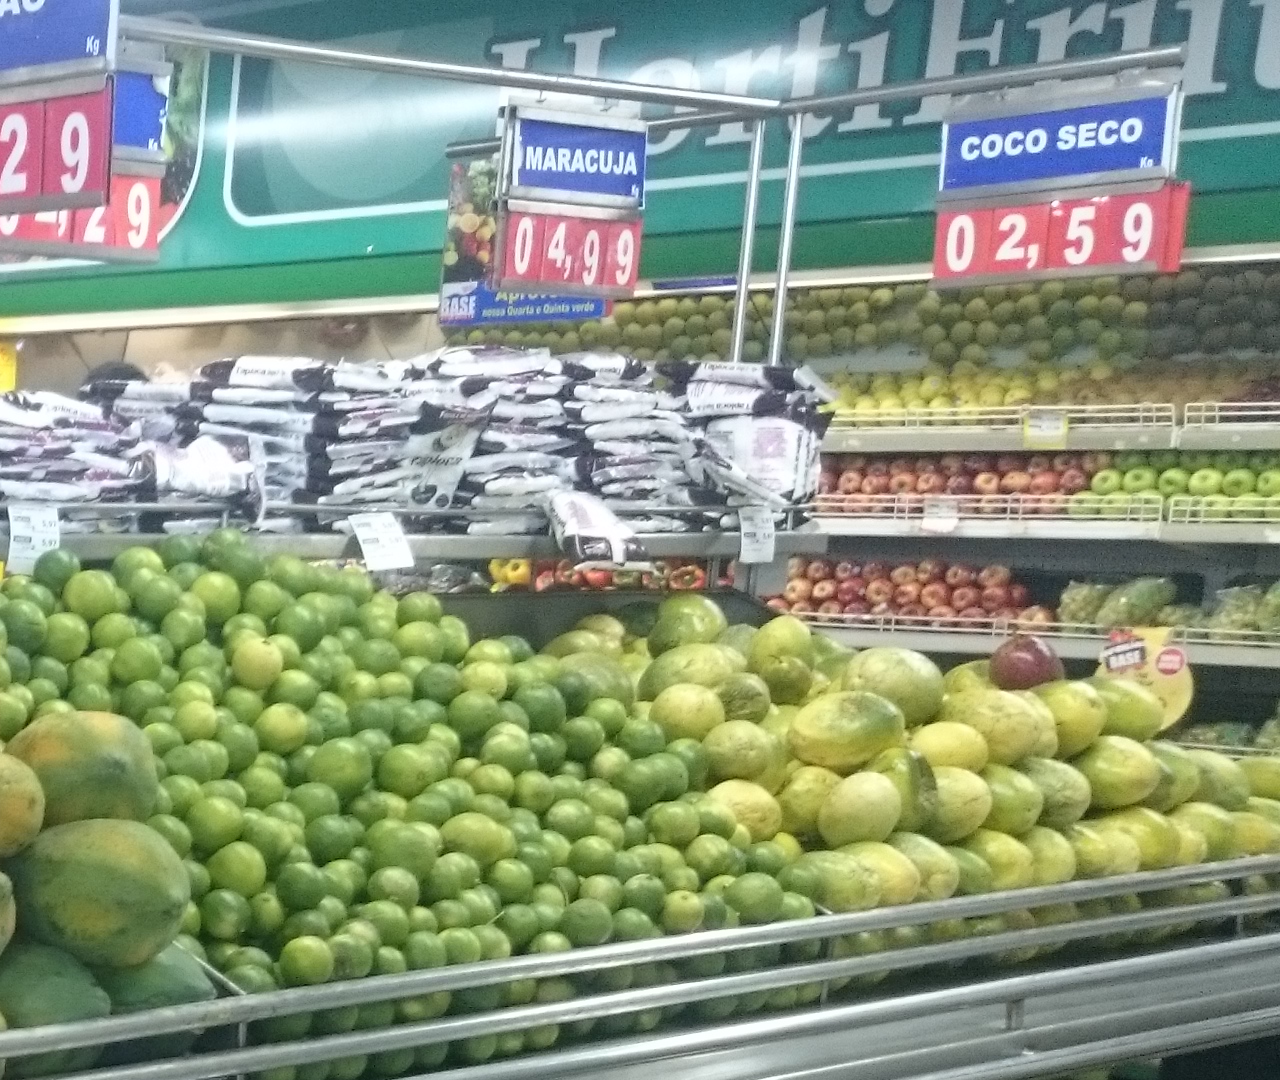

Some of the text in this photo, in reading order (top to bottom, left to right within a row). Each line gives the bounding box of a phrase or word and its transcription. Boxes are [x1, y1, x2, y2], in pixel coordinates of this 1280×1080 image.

[86, 36, 100, 56] Kg
[525, 145, 638, 176] MARACUJA
[960, 117, 1144, 161] COCO SECO
[514, 215, 635, 287] 04,99
[945, 202, 1154, 273] 02,59
